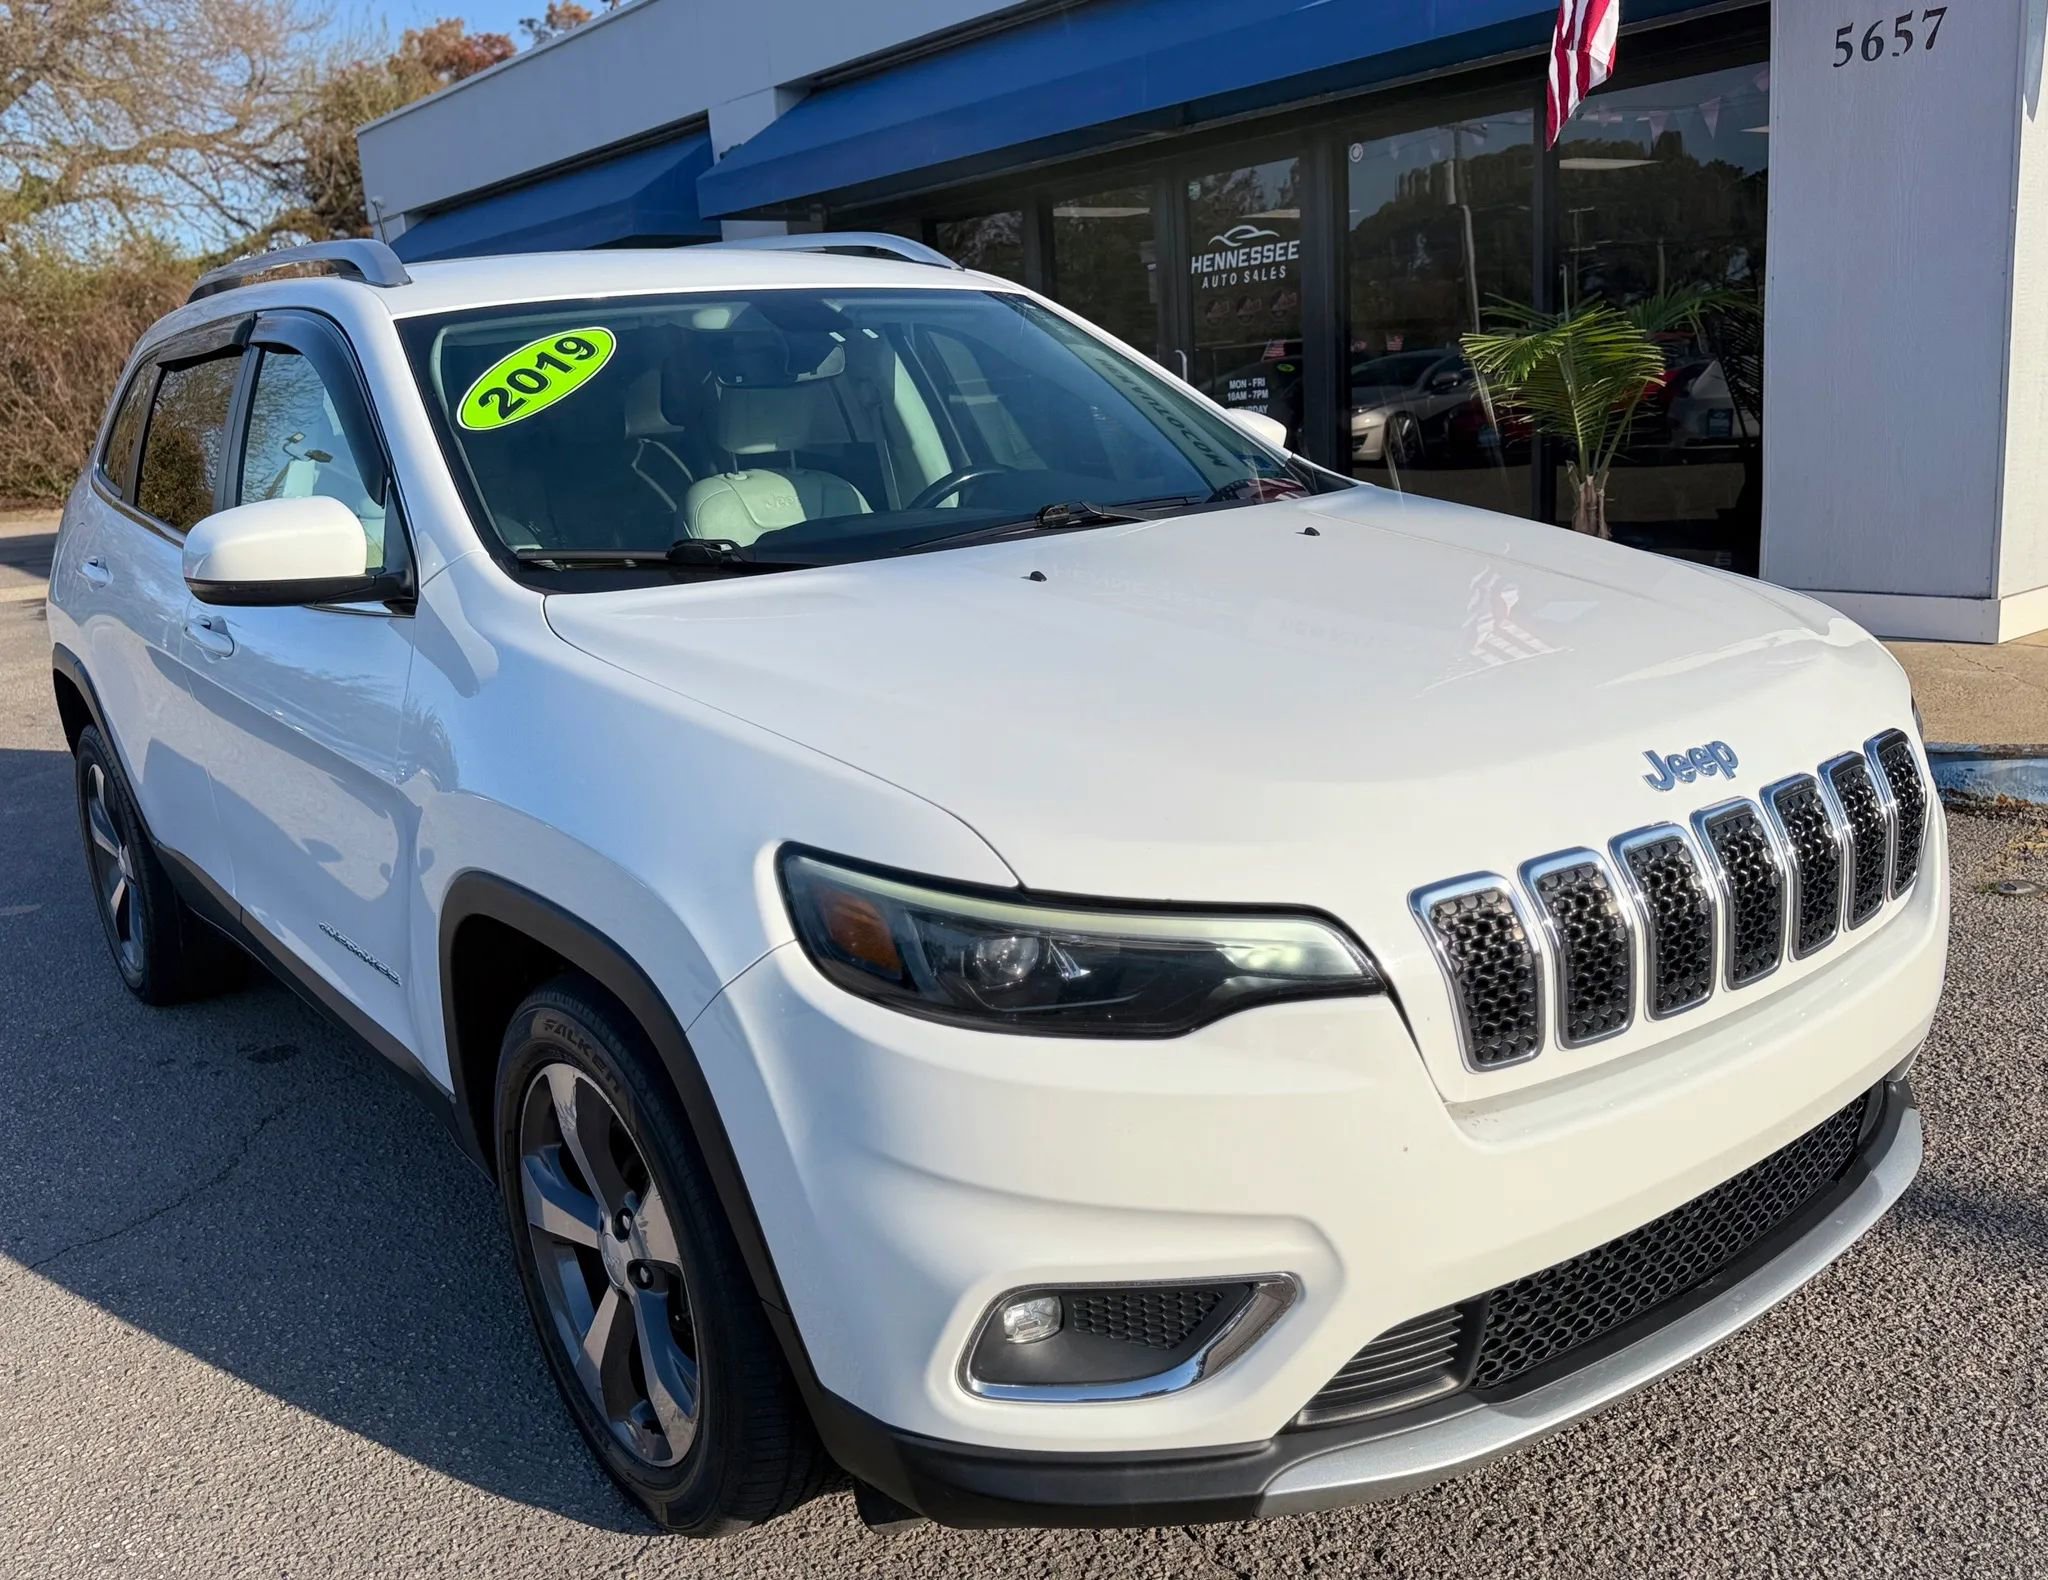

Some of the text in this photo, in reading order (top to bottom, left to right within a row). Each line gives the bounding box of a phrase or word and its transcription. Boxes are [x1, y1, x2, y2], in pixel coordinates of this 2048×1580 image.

[1832, 6, 1948, 68] 5657
[1191, 240, 1300, 274] HENNESSEE
[1202, 265, 1287, 289] AUTO SALES
[478, 336, 600, 420] 2019
[1227, 391, 1247, 401] 10AM
[1252, 389, 1269, 399] 7PM
[1229, 379, 1247, 389] MON
[1252, 377, 1266, 388] FRI
[1642, 740, 1739, 792] Jeep
[543, 1018, 622, 1094] FALKEN
